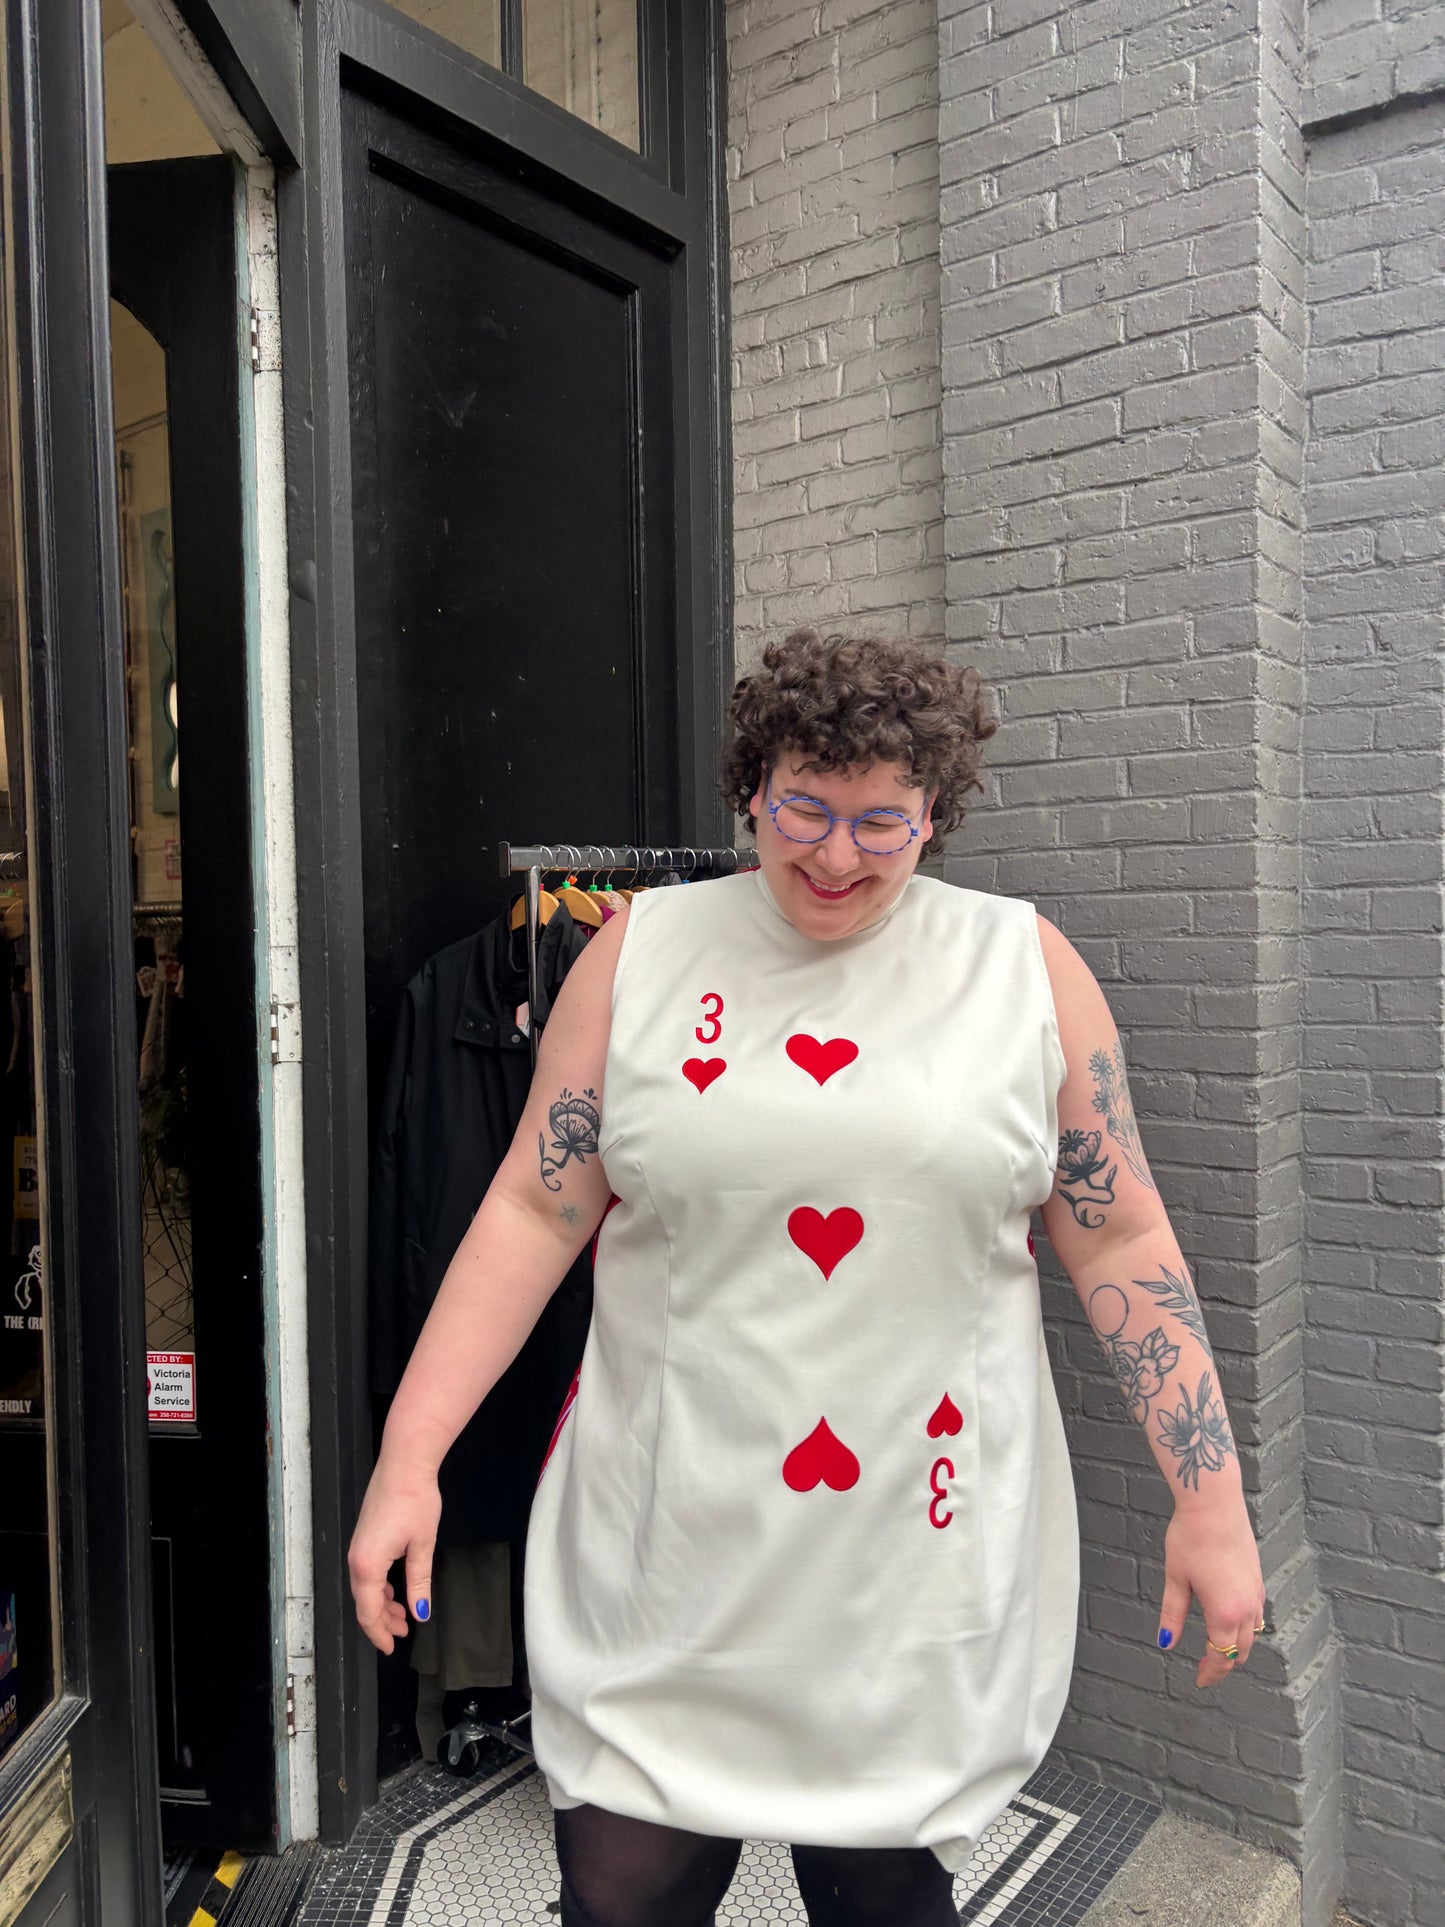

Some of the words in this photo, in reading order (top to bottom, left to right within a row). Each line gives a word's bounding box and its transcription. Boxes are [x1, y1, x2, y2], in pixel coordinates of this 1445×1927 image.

[695, 992, 724, 1044] 3
[4, 1315, 24, 1329] THE
[169, 1355, 184, 1363] BY:
[153, 1369, 191, 1378] Victoria
[154, 1382, 183, 1391] Alarm
[154, 1396, 190, 1405] Service
[929, 1456, 955, 1529] 3
